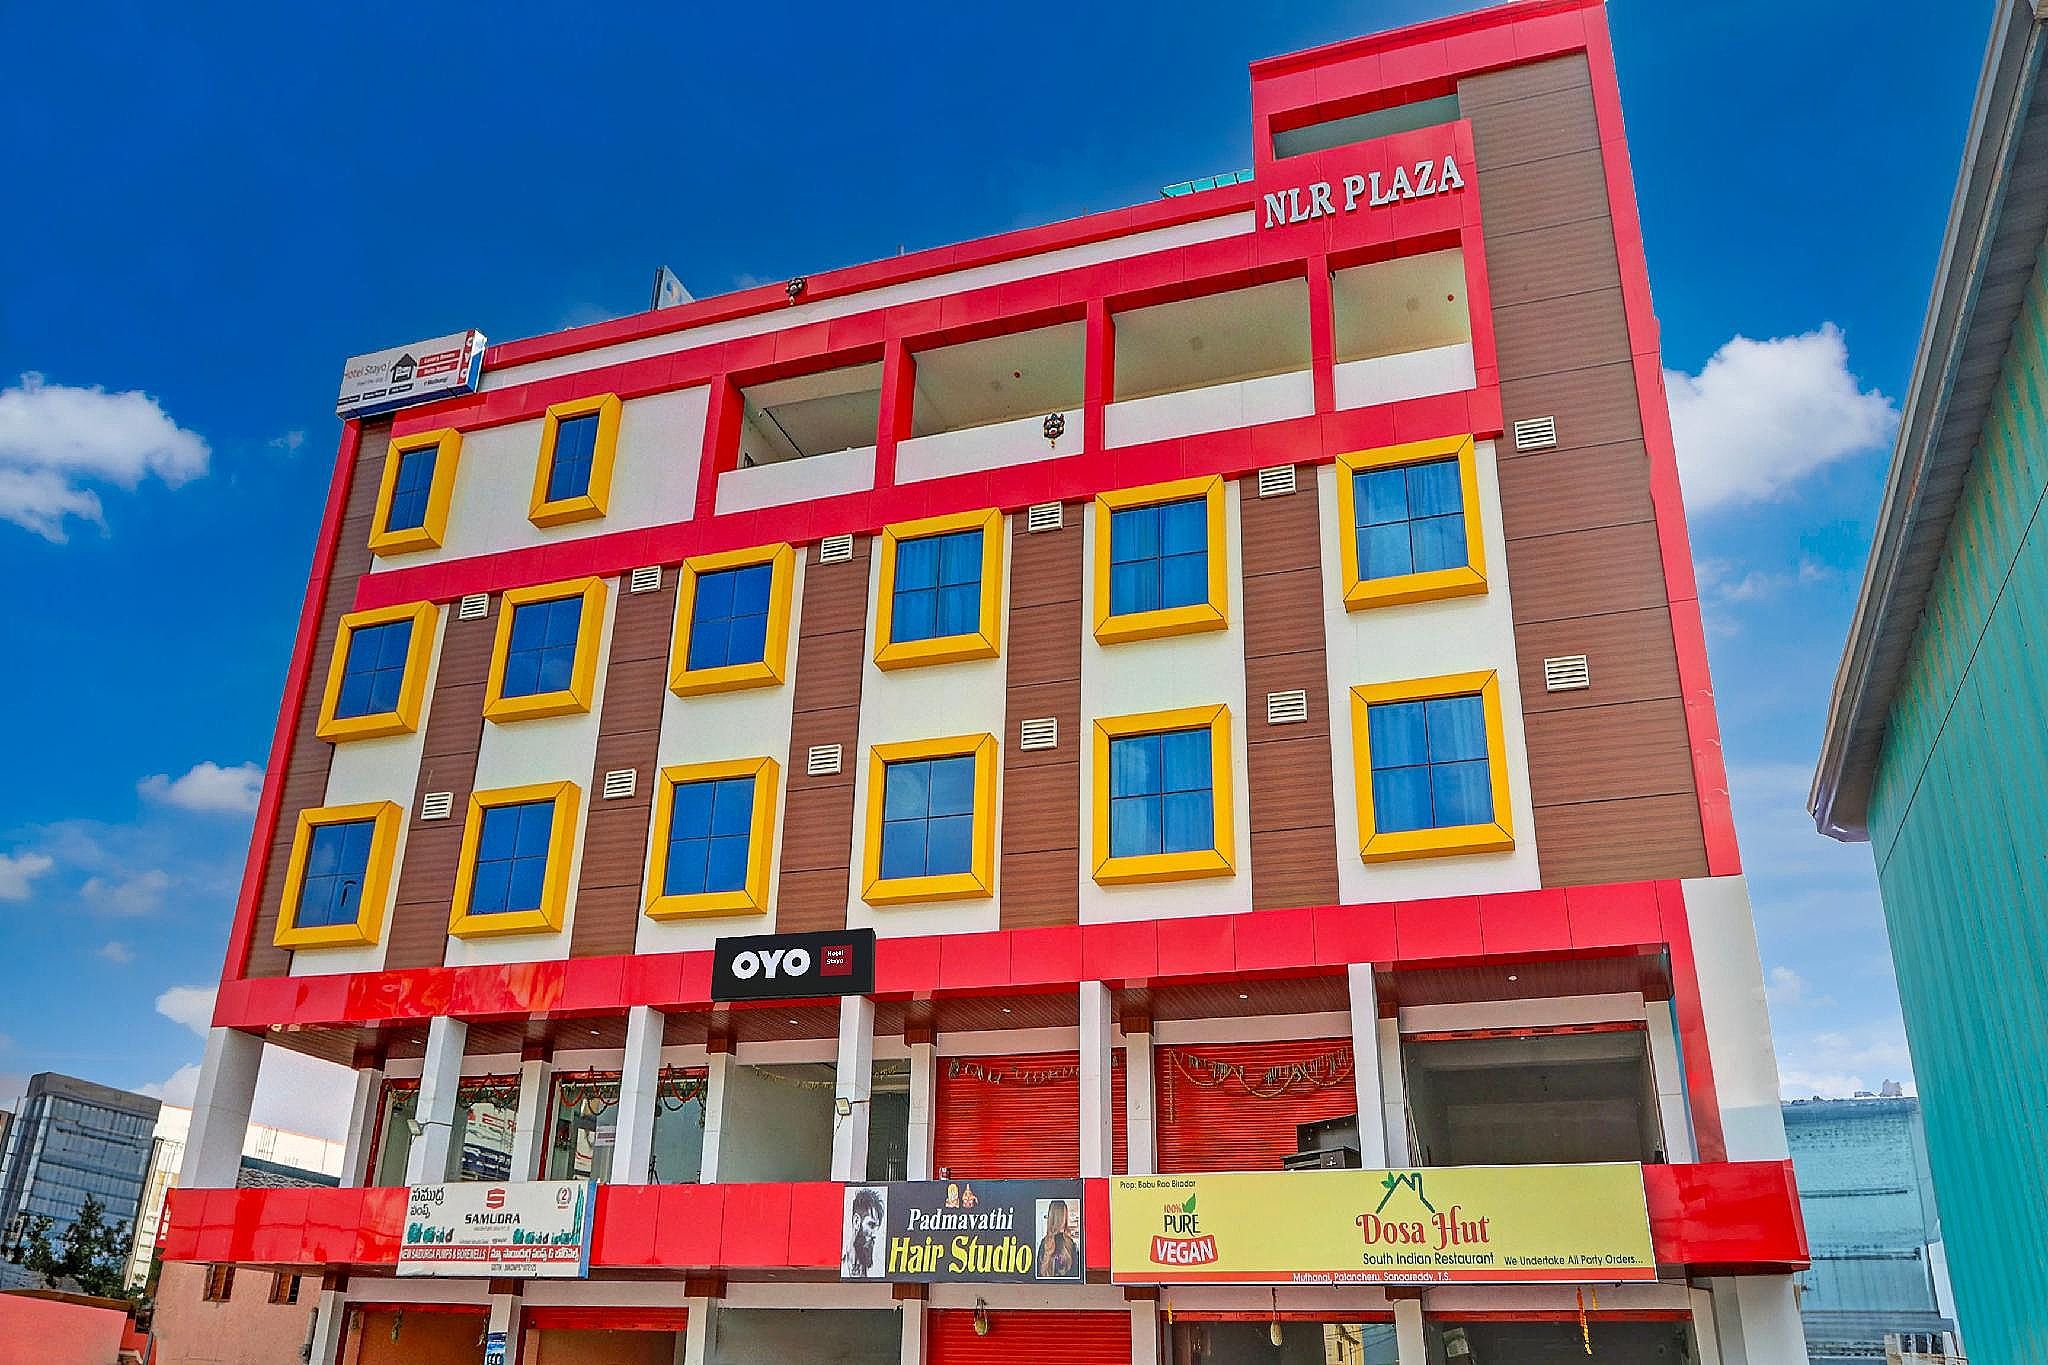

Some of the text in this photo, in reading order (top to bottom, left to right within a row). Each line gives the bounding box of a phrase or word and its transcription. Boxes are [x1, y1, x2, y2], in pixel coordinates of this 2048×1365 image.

[1264, 155, 1465, 229] NLR PLAZA
[731, 948, 811, 980] OYO
[464, 1213, 521, 1225] SAMUDRA
[906, 1207, 1014, 1232] Padmavathi
[1163, 1214, 1201, 1237] PURE
[1355, 1205, 1490, 1251] Dosa Hut
[888, 1234, 1034, 1274] Hair Studio
[1155, 1238, 1215, 1264] VEGAN
[1363, 1251, 1495, 1265] South Indian Restaurant
[1504, 1256, 1518, 1266] We
[1519, 1255, 1566, 1266] Undertake
[1567, 1255, 1582, 1265] All
